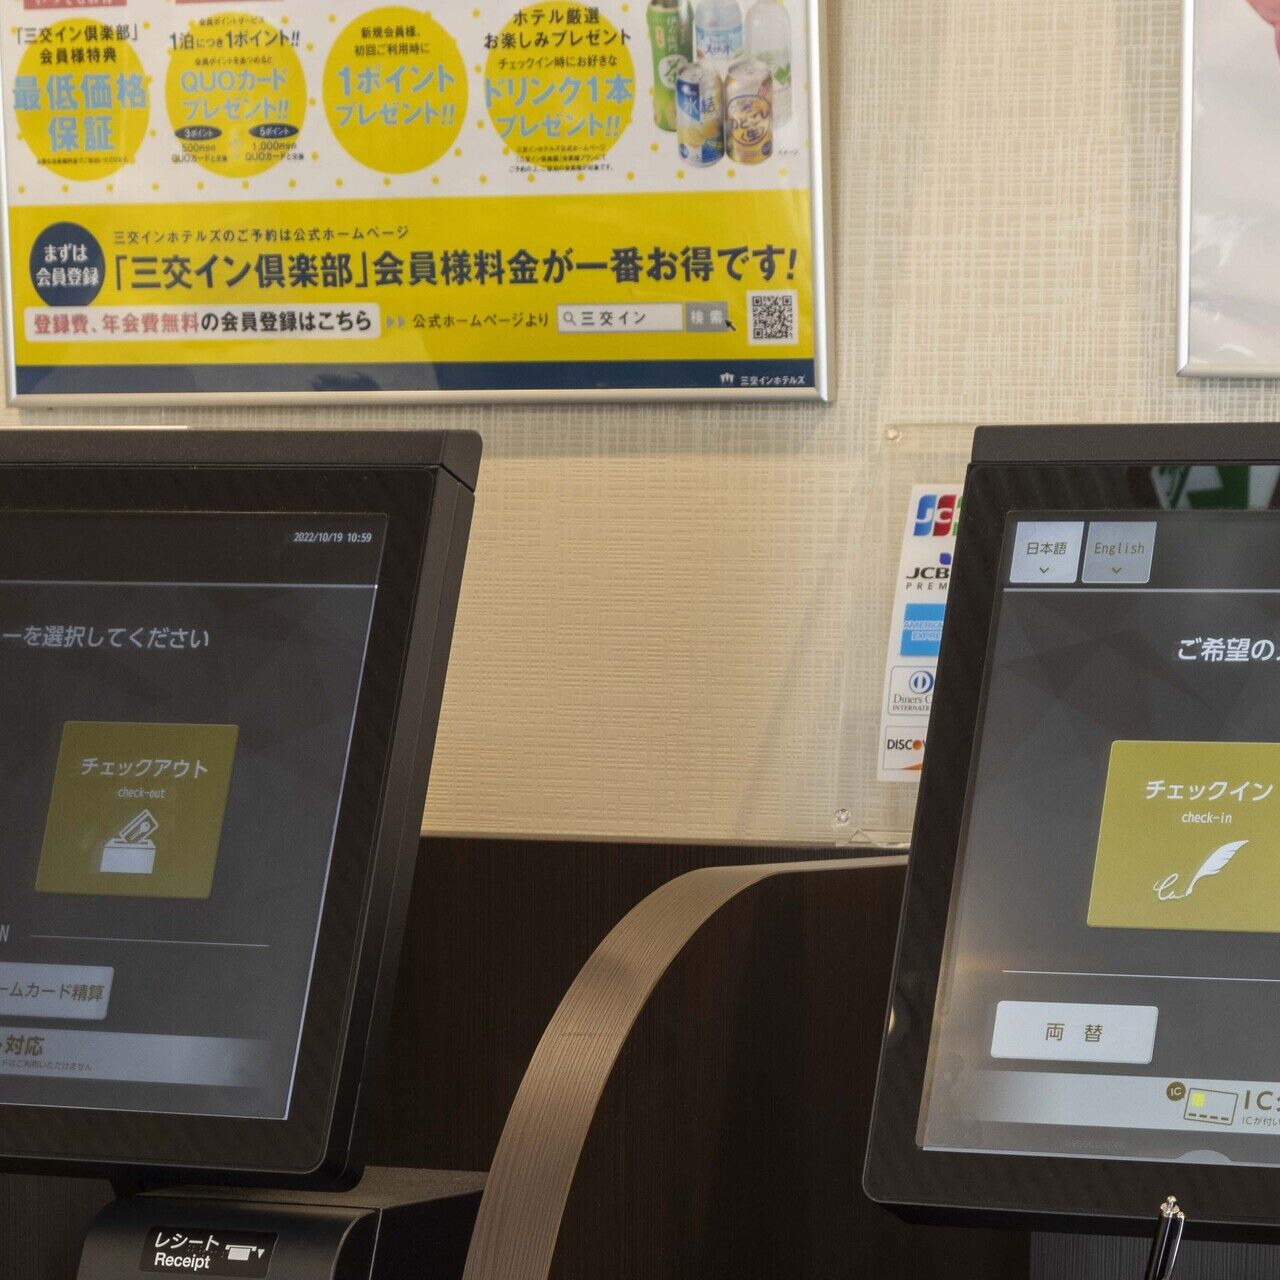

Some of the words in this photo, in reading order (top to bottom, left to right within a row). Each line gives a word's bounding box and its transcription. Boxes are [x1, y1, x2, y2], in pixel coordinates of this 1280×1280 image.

[484, 28, 632, 50] お楽しみプレゼント
[40, 48, 117, 65] 会員様特典
[498, 55, 618, 71] チェックイン時にお好きな
[180, 67, 288, 93] QUOカード
[338, 64, 455, 97] 1ポイント
[12, 72, 147, 112] 最低価格
[484, 73, 634, 107] ドリンク1本
[48, 115, 114, 152] 保証
[113, 225, 410, 244] 三交インホテルズのご予約は公式ホームページ
[44, 243, 88, 263] まずは
[36, 267, 99, 288] 会員登録
[412, 312, 549, 329] 公式ホームページより
[294, 531, 343, 544] 2022/10/19
[1027, 541, 1067, 556] 日本語
[1094, 541, 1145, 557] English
[906, 566, 950, 579] JCB
[906, 581, 949, 591] PREM
[80, 757, 209, 780] チェックアウト
[1145, 778, 1274, 802] チェックイン
[1181, 810, 1233, 825] check-in
[154, 1231, 220, 1250] レシート
[154, 1252, 211, 1271] Receipt
